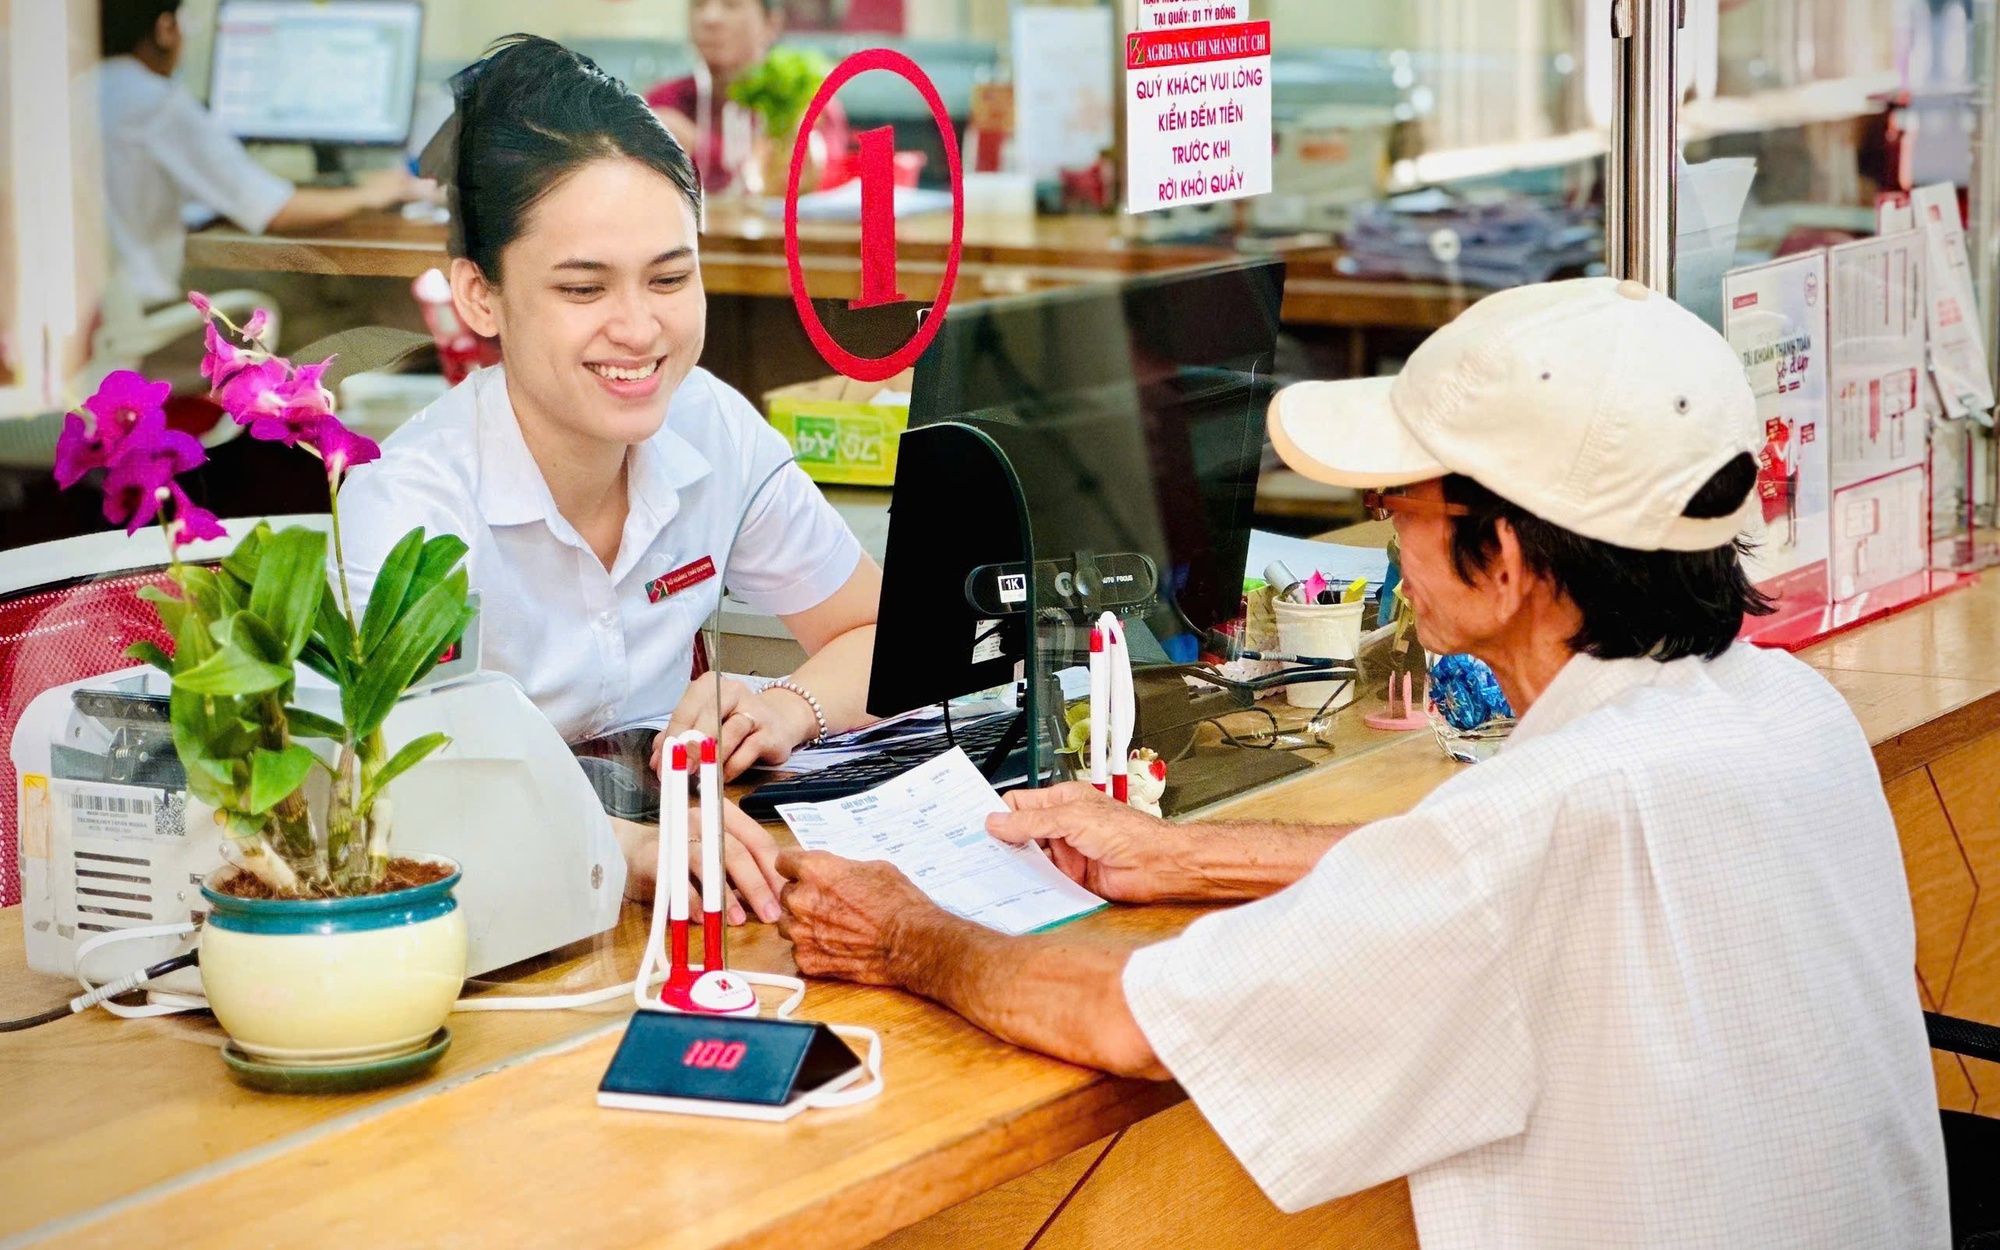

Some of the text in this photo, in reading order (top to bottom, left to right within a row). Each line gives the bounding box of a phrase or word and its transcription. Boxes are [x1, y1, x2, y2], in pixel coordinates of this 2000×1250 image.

[1153, 12, 1166, 28] TẠI
[1192, 9, 1202, 22] 01
[1204, 4, 1213, 21] TỶ
[1146, 30, 1266, 61] AGRIBANK CHI NHÁNH CỦ CHI
[1136, 65, 1263, 99] QUÝ KHÁCH VUI LÒNG
[1158, 97, 1243, 132] KIỂM ĐẾM TIỀN
[1172, 138, 1231, 165] TRƯỚC KHI
[1158, 177, 1178, 201] RỜI
[1181, 170, 1207, 198] KHỎI
[848, 124, 909, 311] 1
[1116, 574, 1134, 583] FOCUS
[683, 1041, 747, 1070] 100
